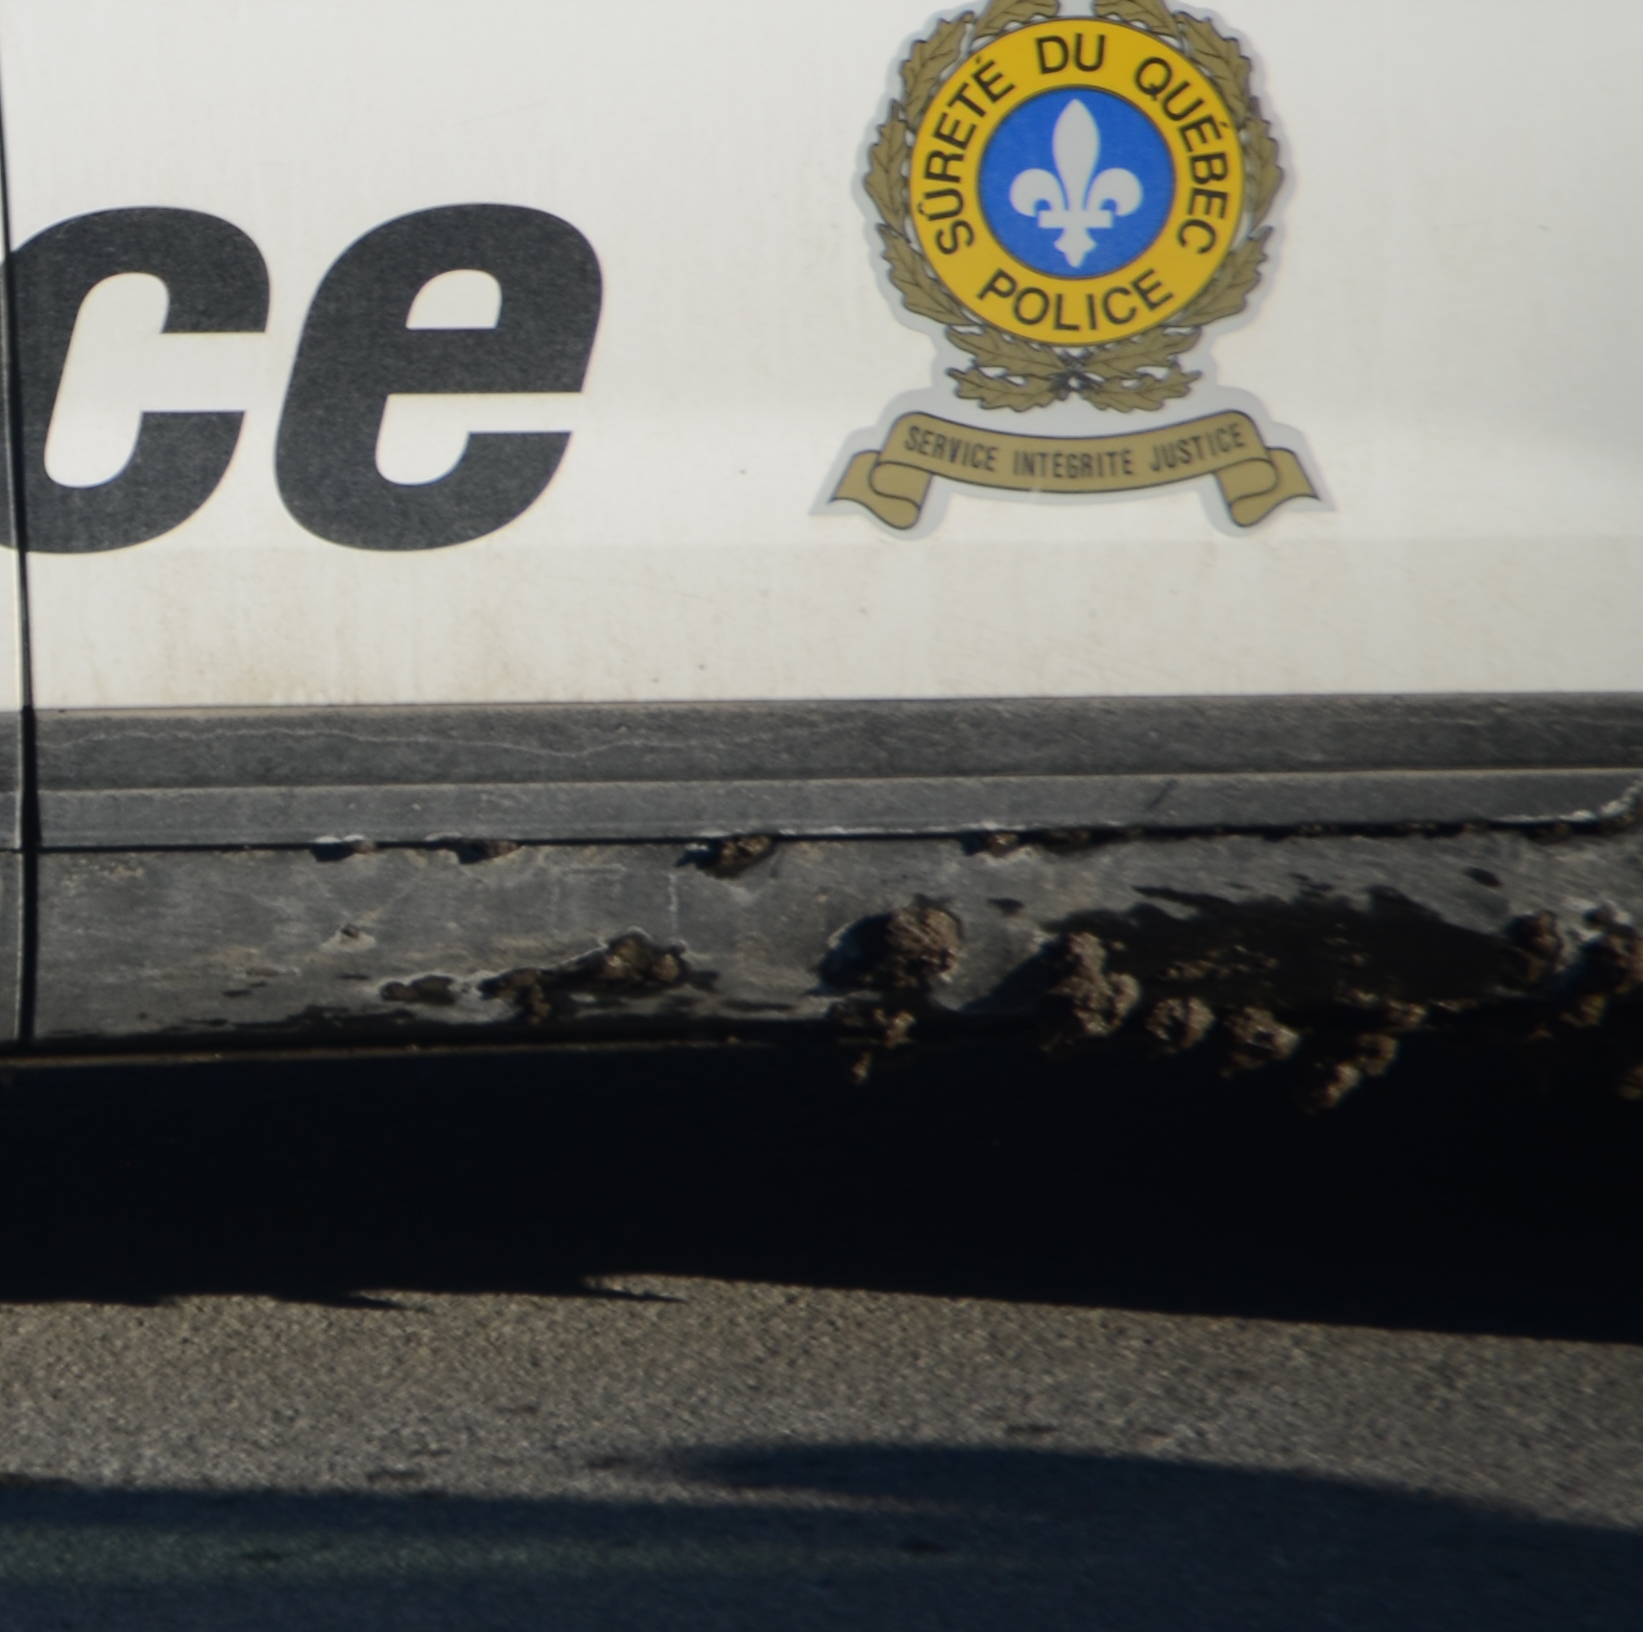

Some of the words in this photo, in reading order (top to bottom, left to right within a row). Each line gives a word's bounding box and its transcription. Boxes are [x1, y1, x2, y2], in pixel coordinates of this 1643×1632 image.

[915, 54, 1016, 257] SÛRETÉ
[1034, 33, 1108, 75] DU
[1134, 54, 1231, 257] QUÉBEC
[976, 268, 1175, 333] POLICE
[903, 425, 999, 472] SERVICE
[1148, 422, 1249, 475] JUSTICE
